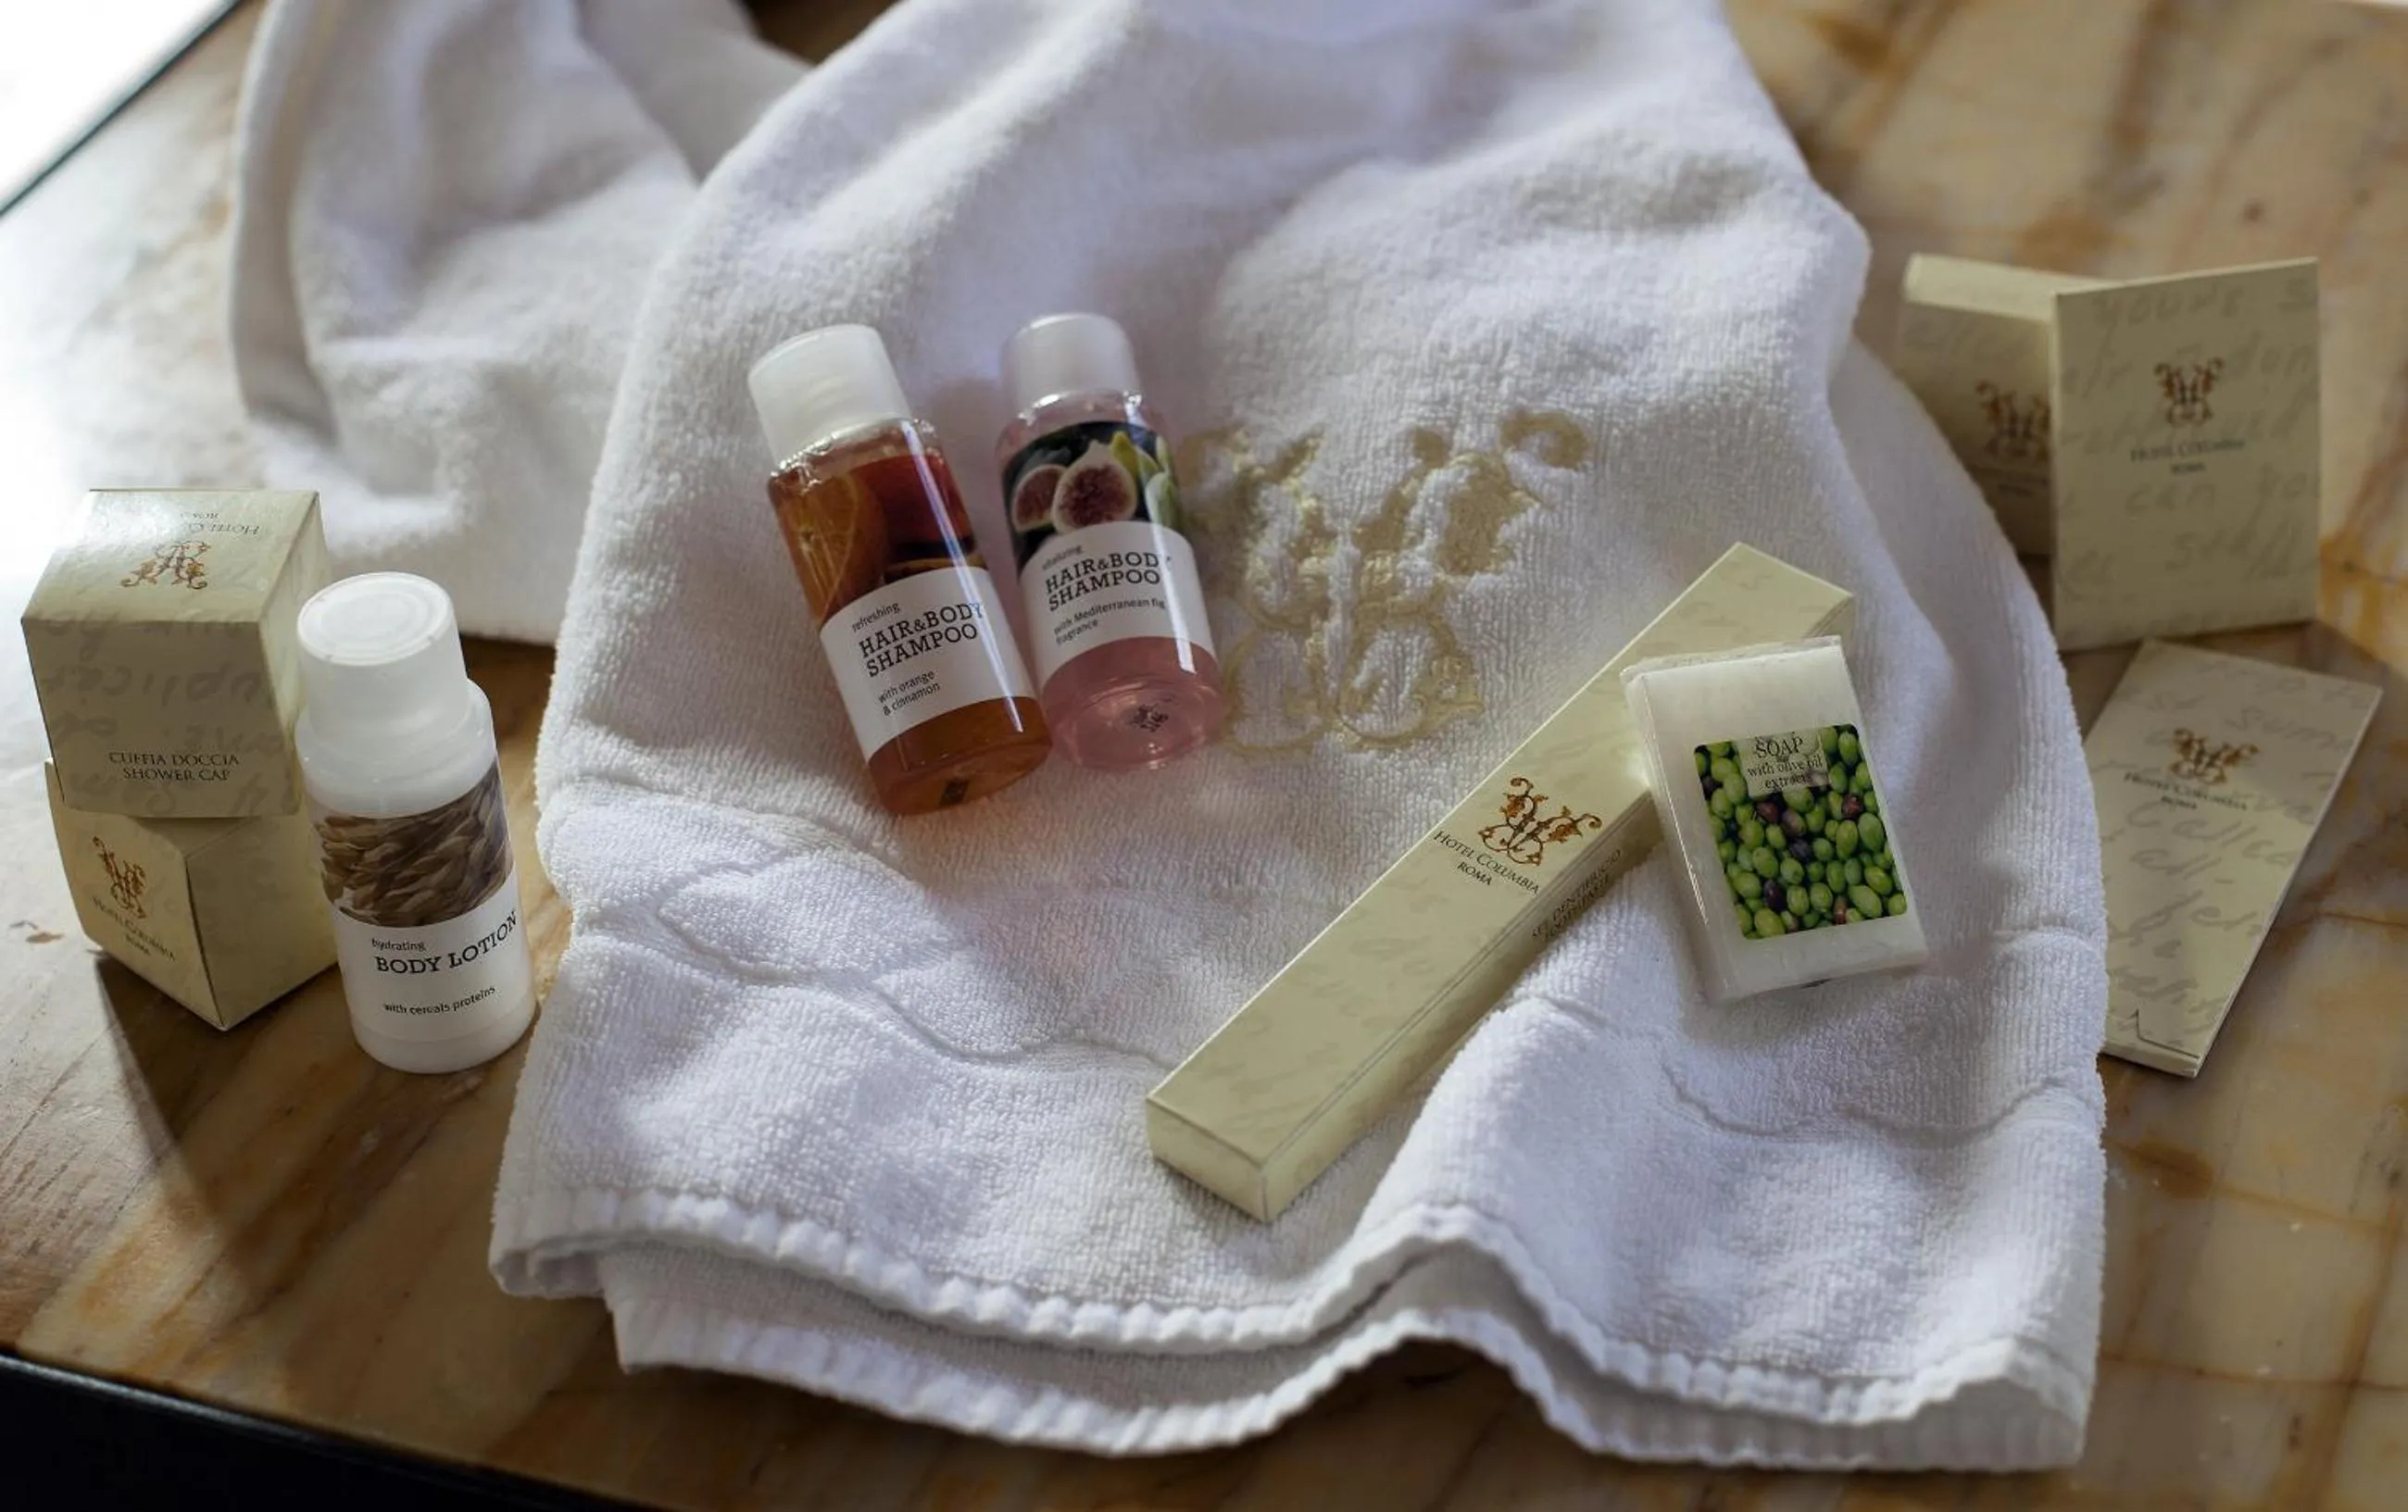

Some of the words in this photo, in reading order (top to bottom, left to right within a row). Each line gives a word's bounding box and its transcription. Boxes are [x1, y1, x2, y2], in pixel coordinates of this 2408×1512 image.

[1045, 552, 1172, 595] HAIR&BOD
[1048, 569, 1160, 612] SHAMPOO
[852, 603, 901, 632] refreshing
[1073, 599, 1150, 622] Mediterranean
[859, 603, 984, 658] HAIR&BODY
[866, 623, 978, 678] SHAMPOO
[878, 687, 898, 704] with
[898, 670, 935, 694] orange
[892, 682, 941, 711] cinnamon
[108, 752, 167, 766] CUFFIA
[171, 753, 240, 767] DOCCIA
[1754, 736, 1803, 758] SOAP
[122, 768, 193, 781] SHOWER
[198, 768, 231, 781] CAP
[1748, 762, 1775, 777] with
[1433, 831, 1474, 859] HOTEL
[1475, 853, 1541, 894] COLUMBIA
[1457, 861, 1494, 886] ROMA
[371, 937, 426, 952] hydrating
[374, 956, 442, 973] BODY
[448, 908, 517, 968] LOTION
[383, 1002, 407, 1015] with
[408, 1004, 450, 1015] cereals
[453, 986, 495, 1011] proteins
